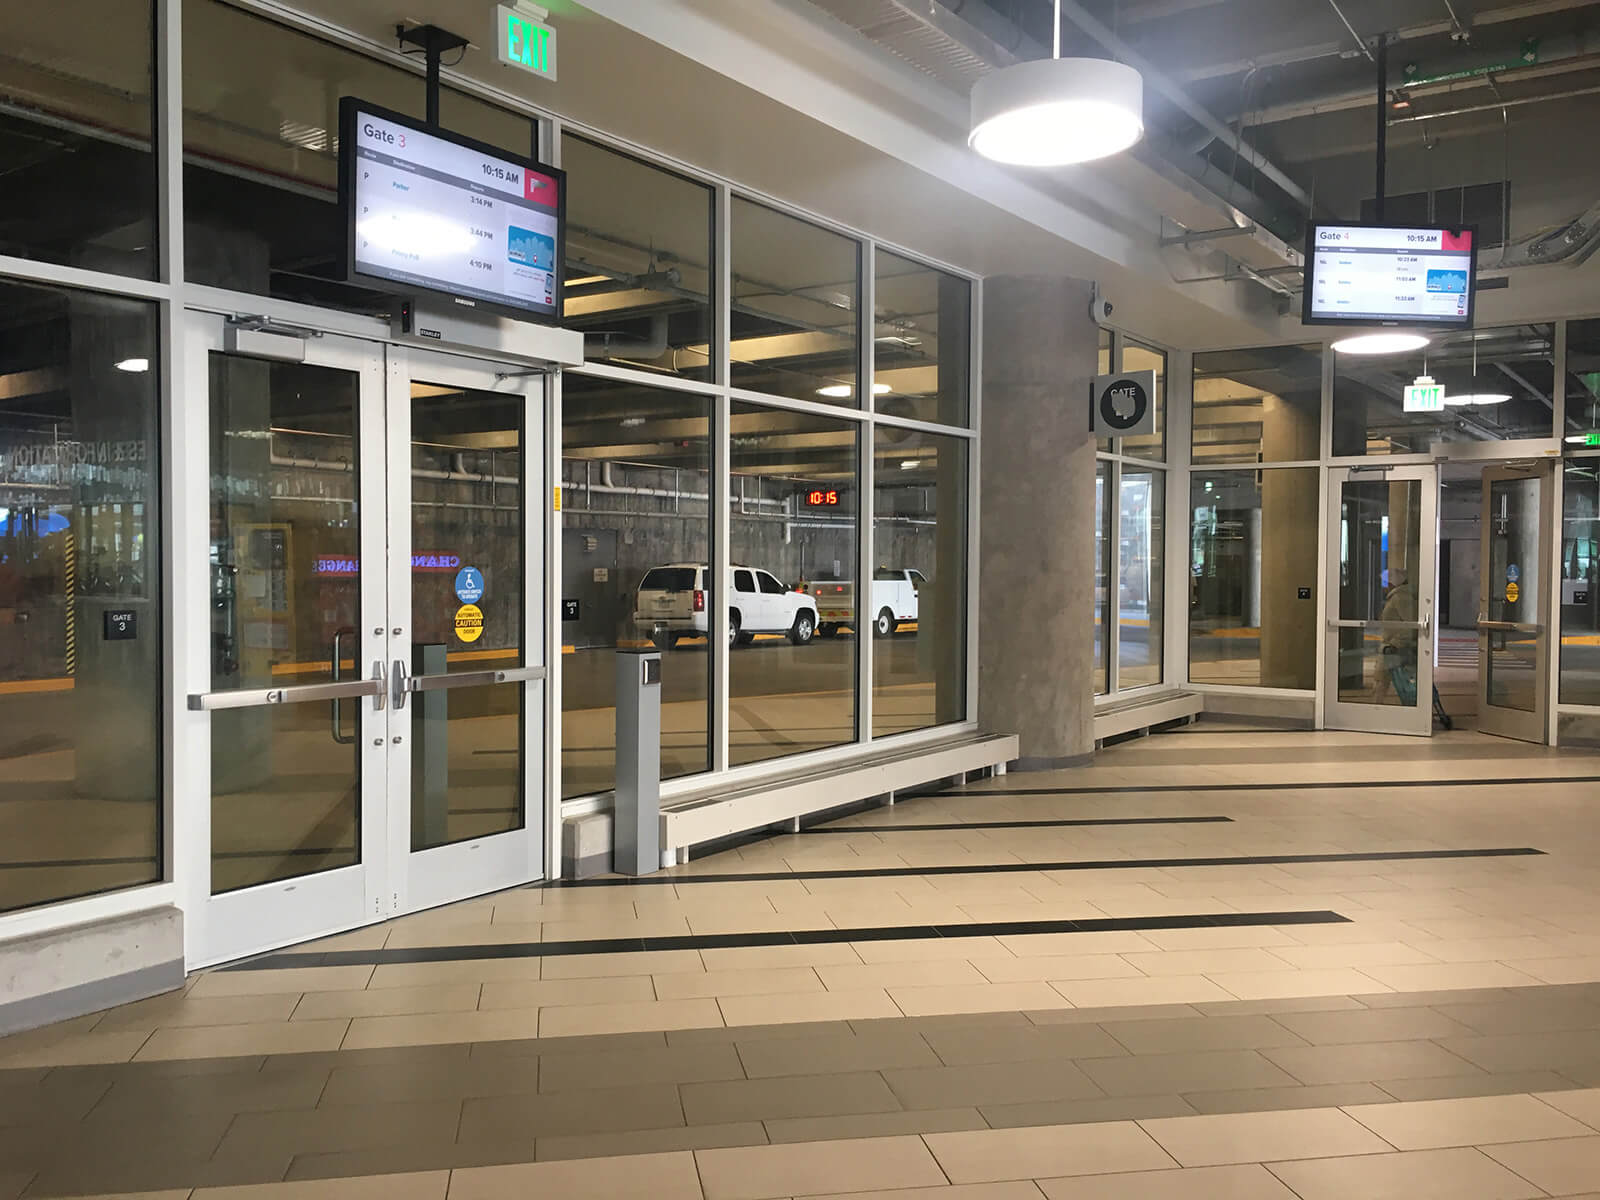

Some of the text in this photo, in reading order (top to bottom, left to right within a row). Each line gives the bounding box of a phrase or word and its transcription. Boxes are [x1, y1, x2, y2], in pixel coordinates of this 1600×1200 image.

[508, 15, 549, 72] EXIT
[364, 123, 406, 148] Gate 3
[482, 164, 519, 184] 10:15 AM
[483, 199, 493, 208] PM
[484, 231, 493, 240] PM
[1320, 232, 1350, 240] Gate 4
[482, 262, 493, 271] PM
[1111, 387, 1136, 397] GATE
[1411, 387, 1440, 408] EXIT
[809, 491, 837, 505] 10:15
[119, 622, 126, 630] 3
[456, 619, 482, 627] CAUTION
